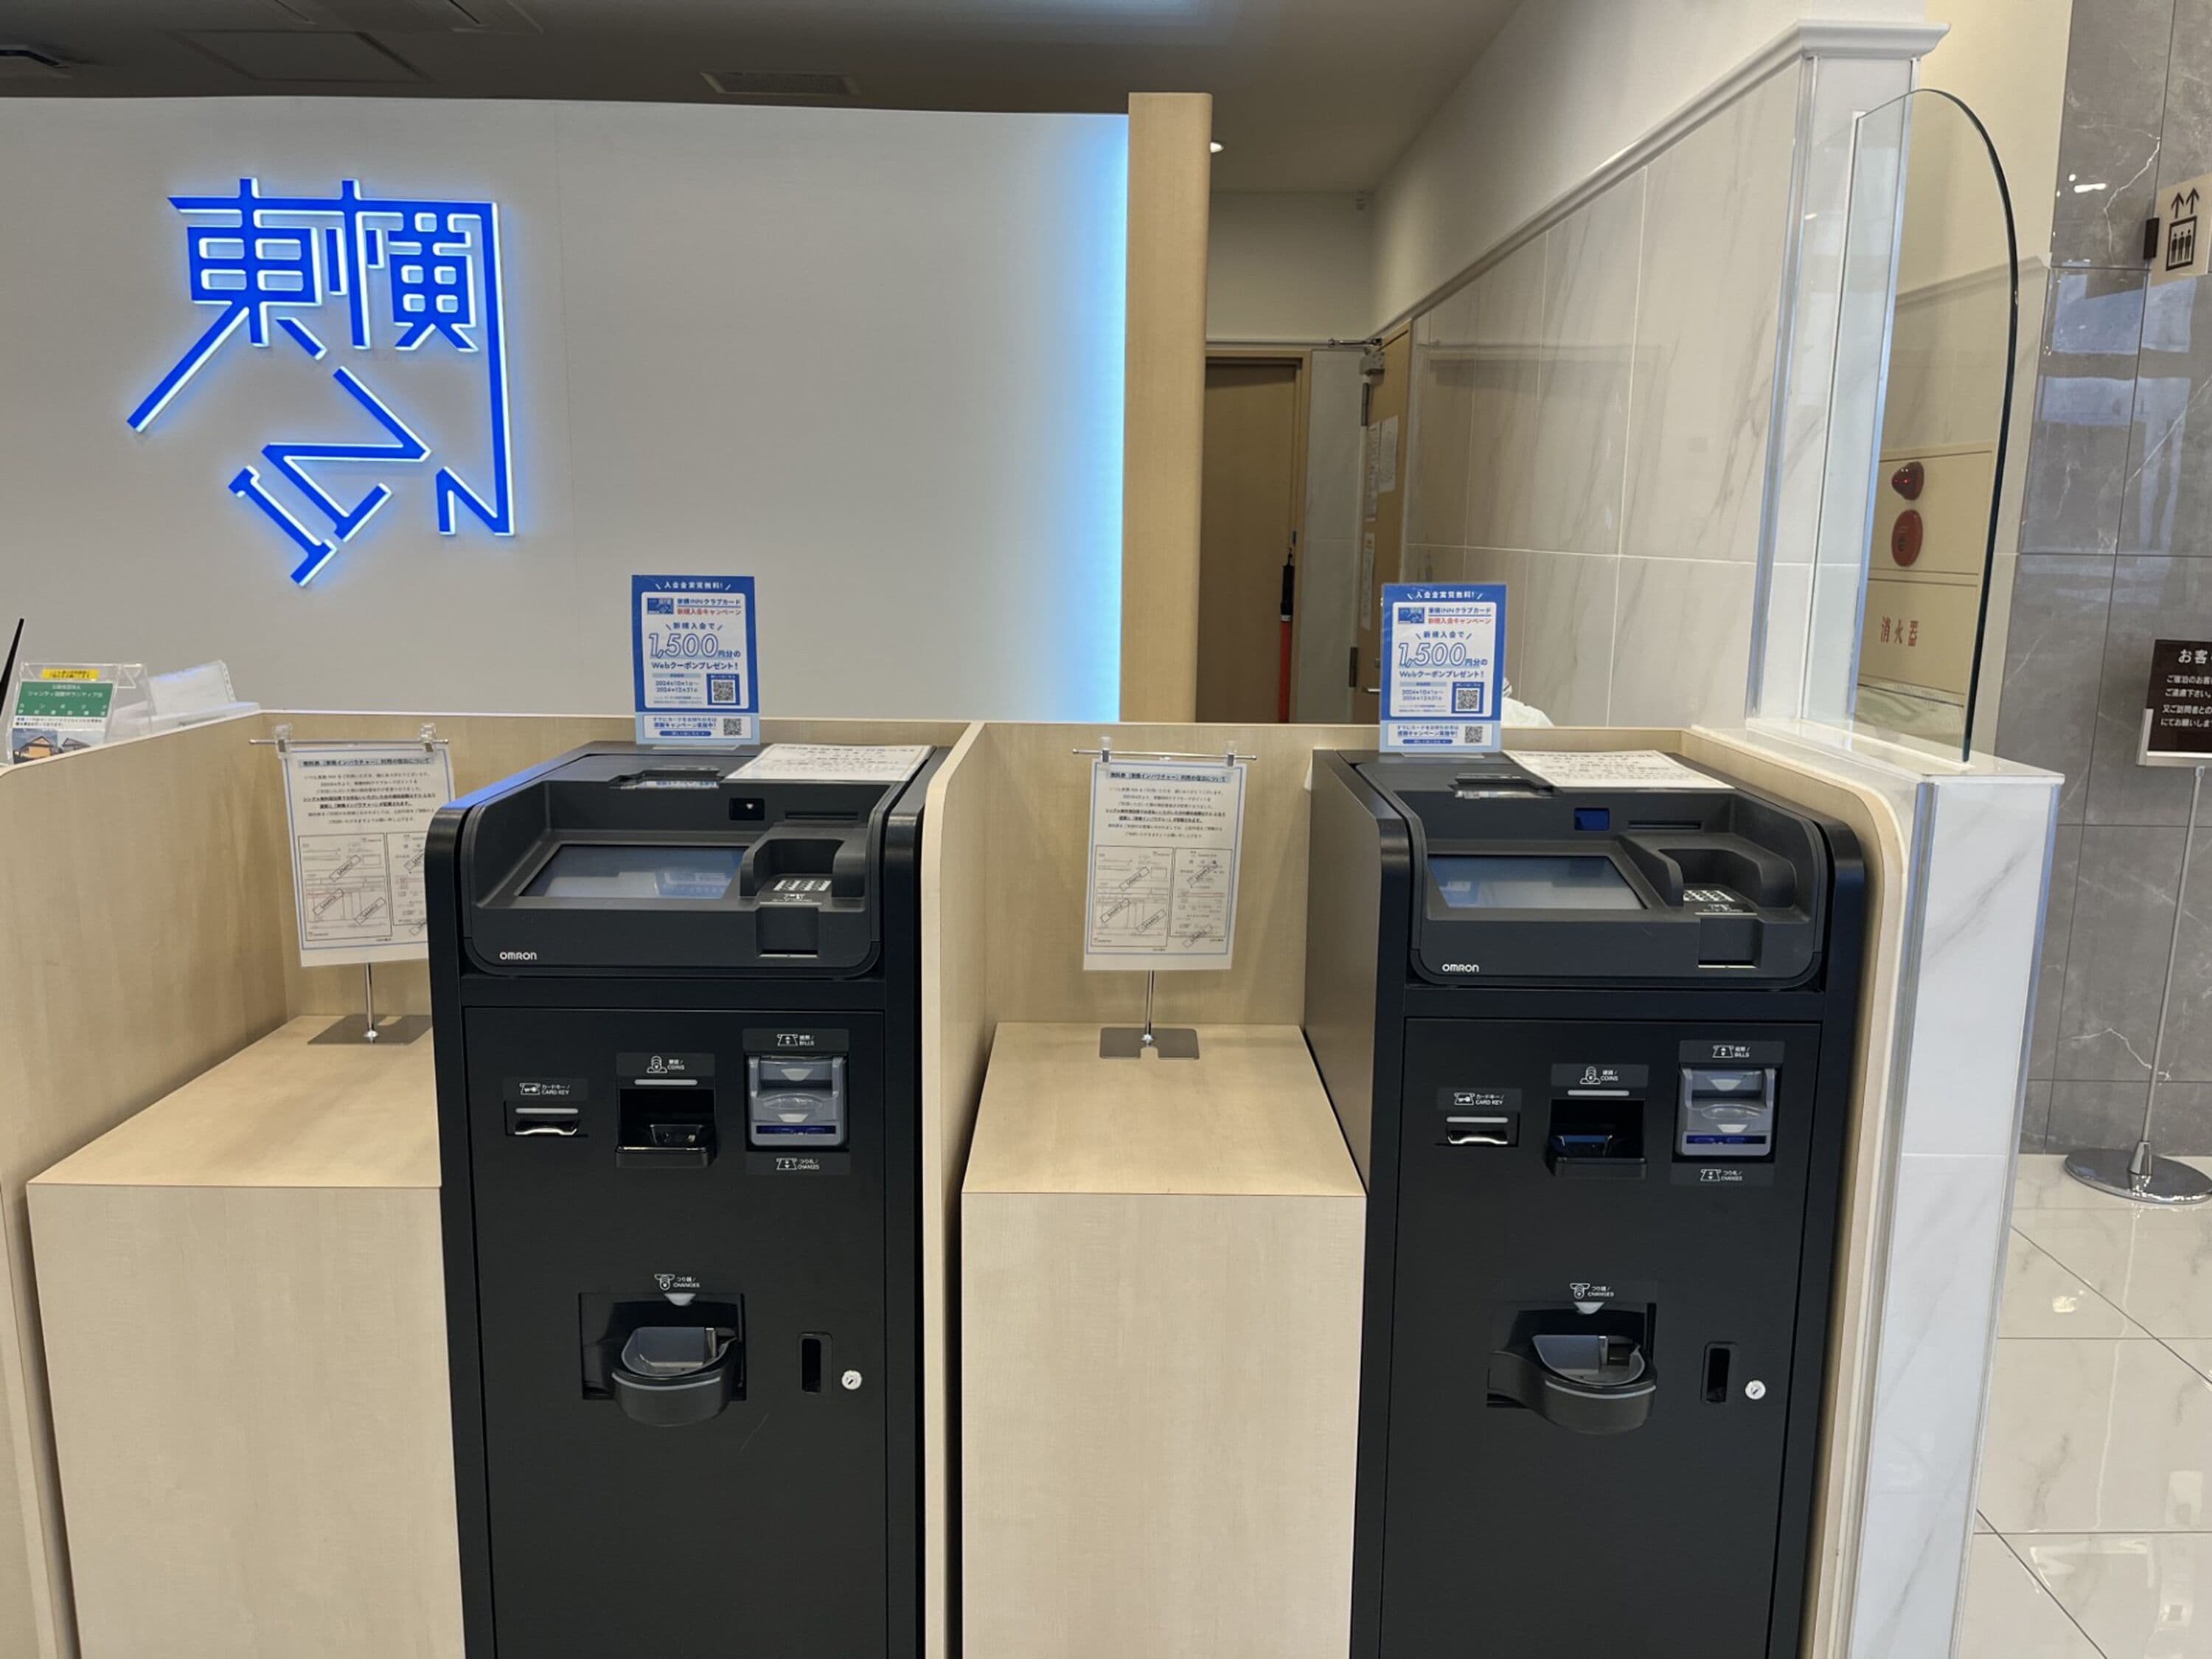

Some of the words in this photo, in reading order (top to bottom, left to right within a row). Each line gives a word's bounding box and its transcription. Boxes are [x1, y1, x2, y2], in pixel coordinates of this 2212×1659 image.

[1880, 617, 1919, 647] 消火器
[2178, 648, 2212, 664] お客
[2166, 675, 2212, 684] ご宿泊のお客
[2160, 718, 2212, 728] にてお願いしま
[499, 951, 537, 960] OMRON
[1441, 964, 1480, 973] OMRON
